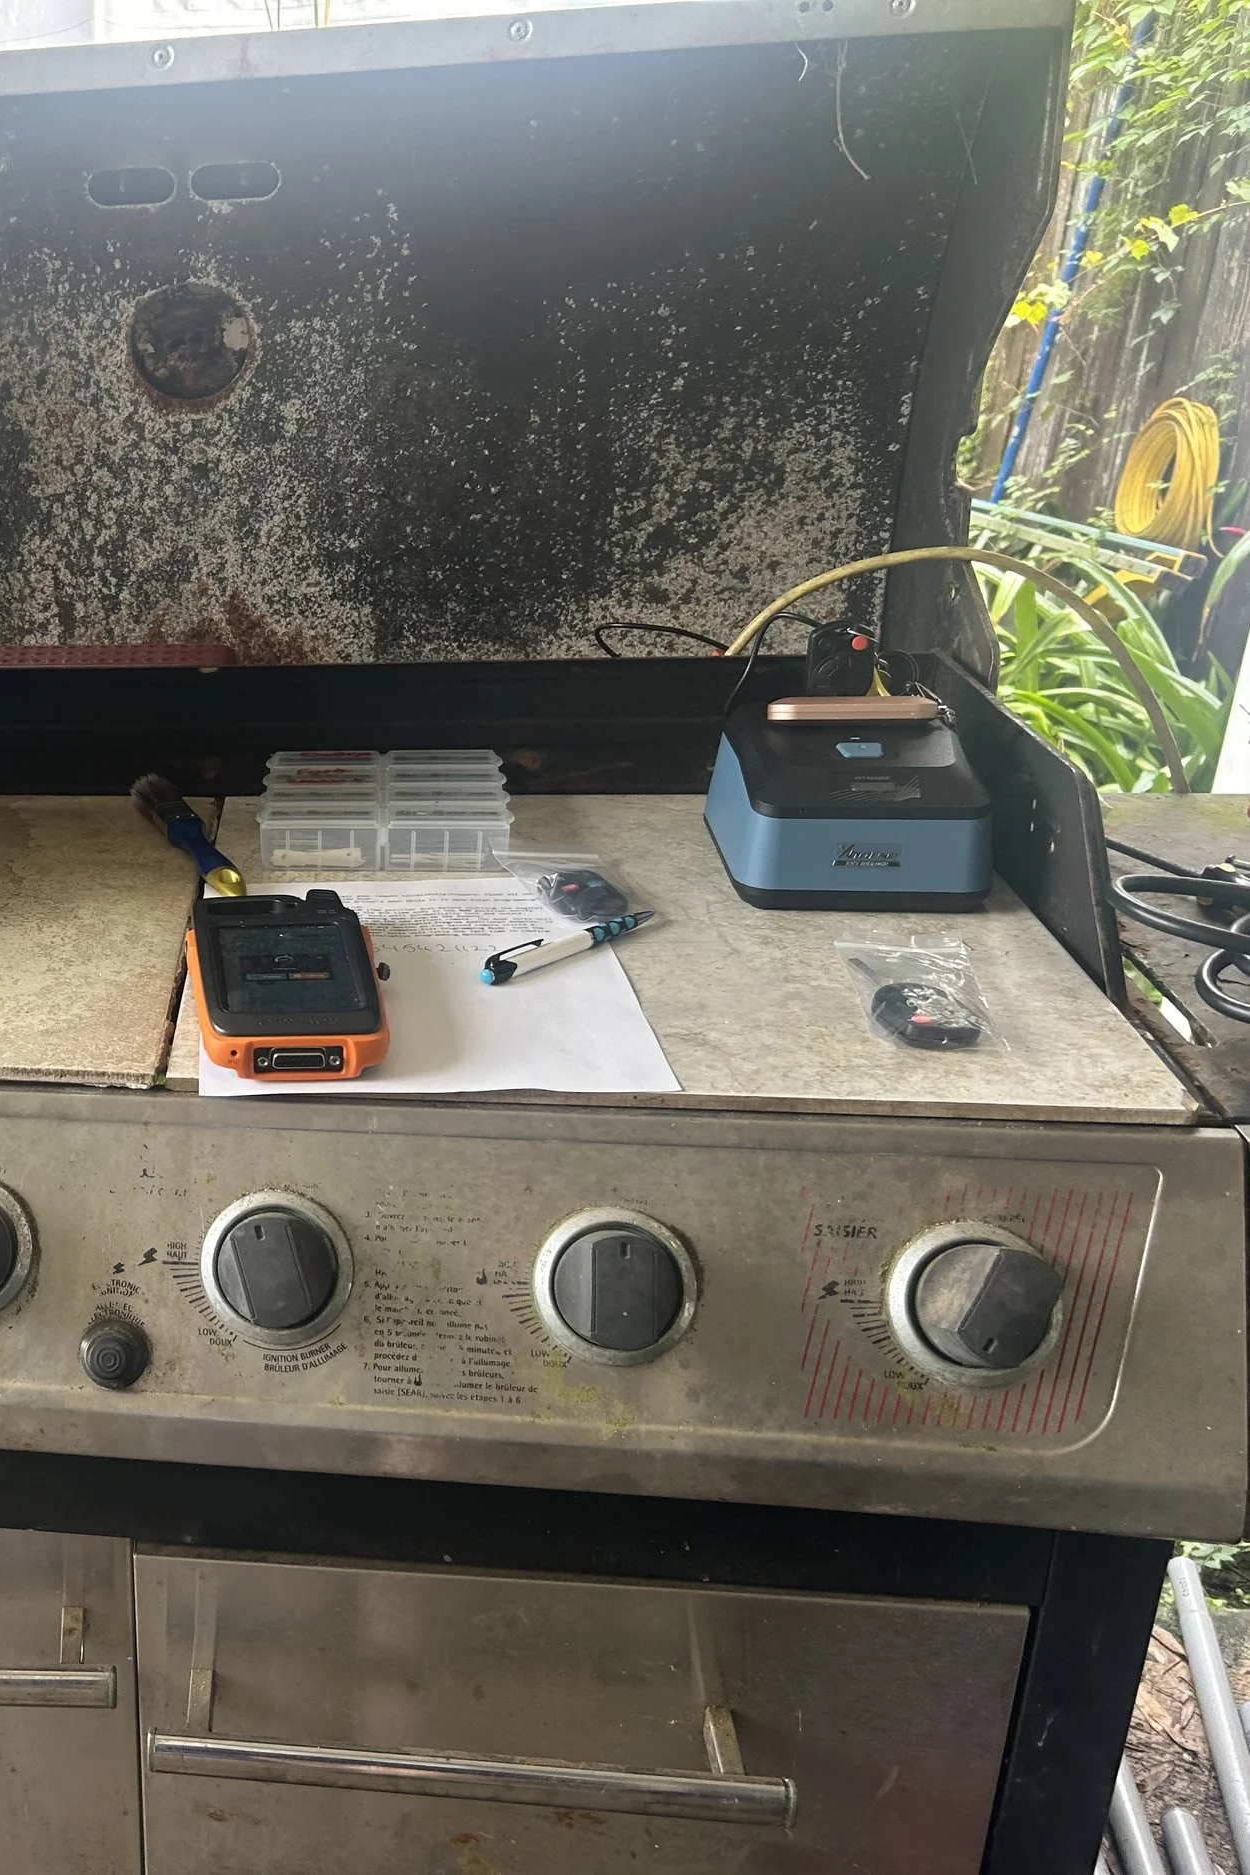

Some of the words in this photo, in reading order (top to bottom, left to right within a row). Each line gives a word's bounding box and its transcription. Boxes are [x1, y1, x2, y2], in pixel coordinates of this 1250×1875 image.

[198, 1328, 217, 1336] LOW
[209, 1338, 233, 1347] DOUX
[374, 1339, 384, 1347] du
[262, 1353, 299, 1362] IGNITION
[300, 1342, 332, 1361] BURNER
[263, 1361, 301, 1373] BRÛLEUR
[301, 1342, 348, 1371] D'ALLUMAGE
[373, 1363, 391, 1371] Pour
[374, 1375, 404, 1384] tourner
[495, 1383, 526, 1393] brûleur
[528, 1385, 538, 1393] de
